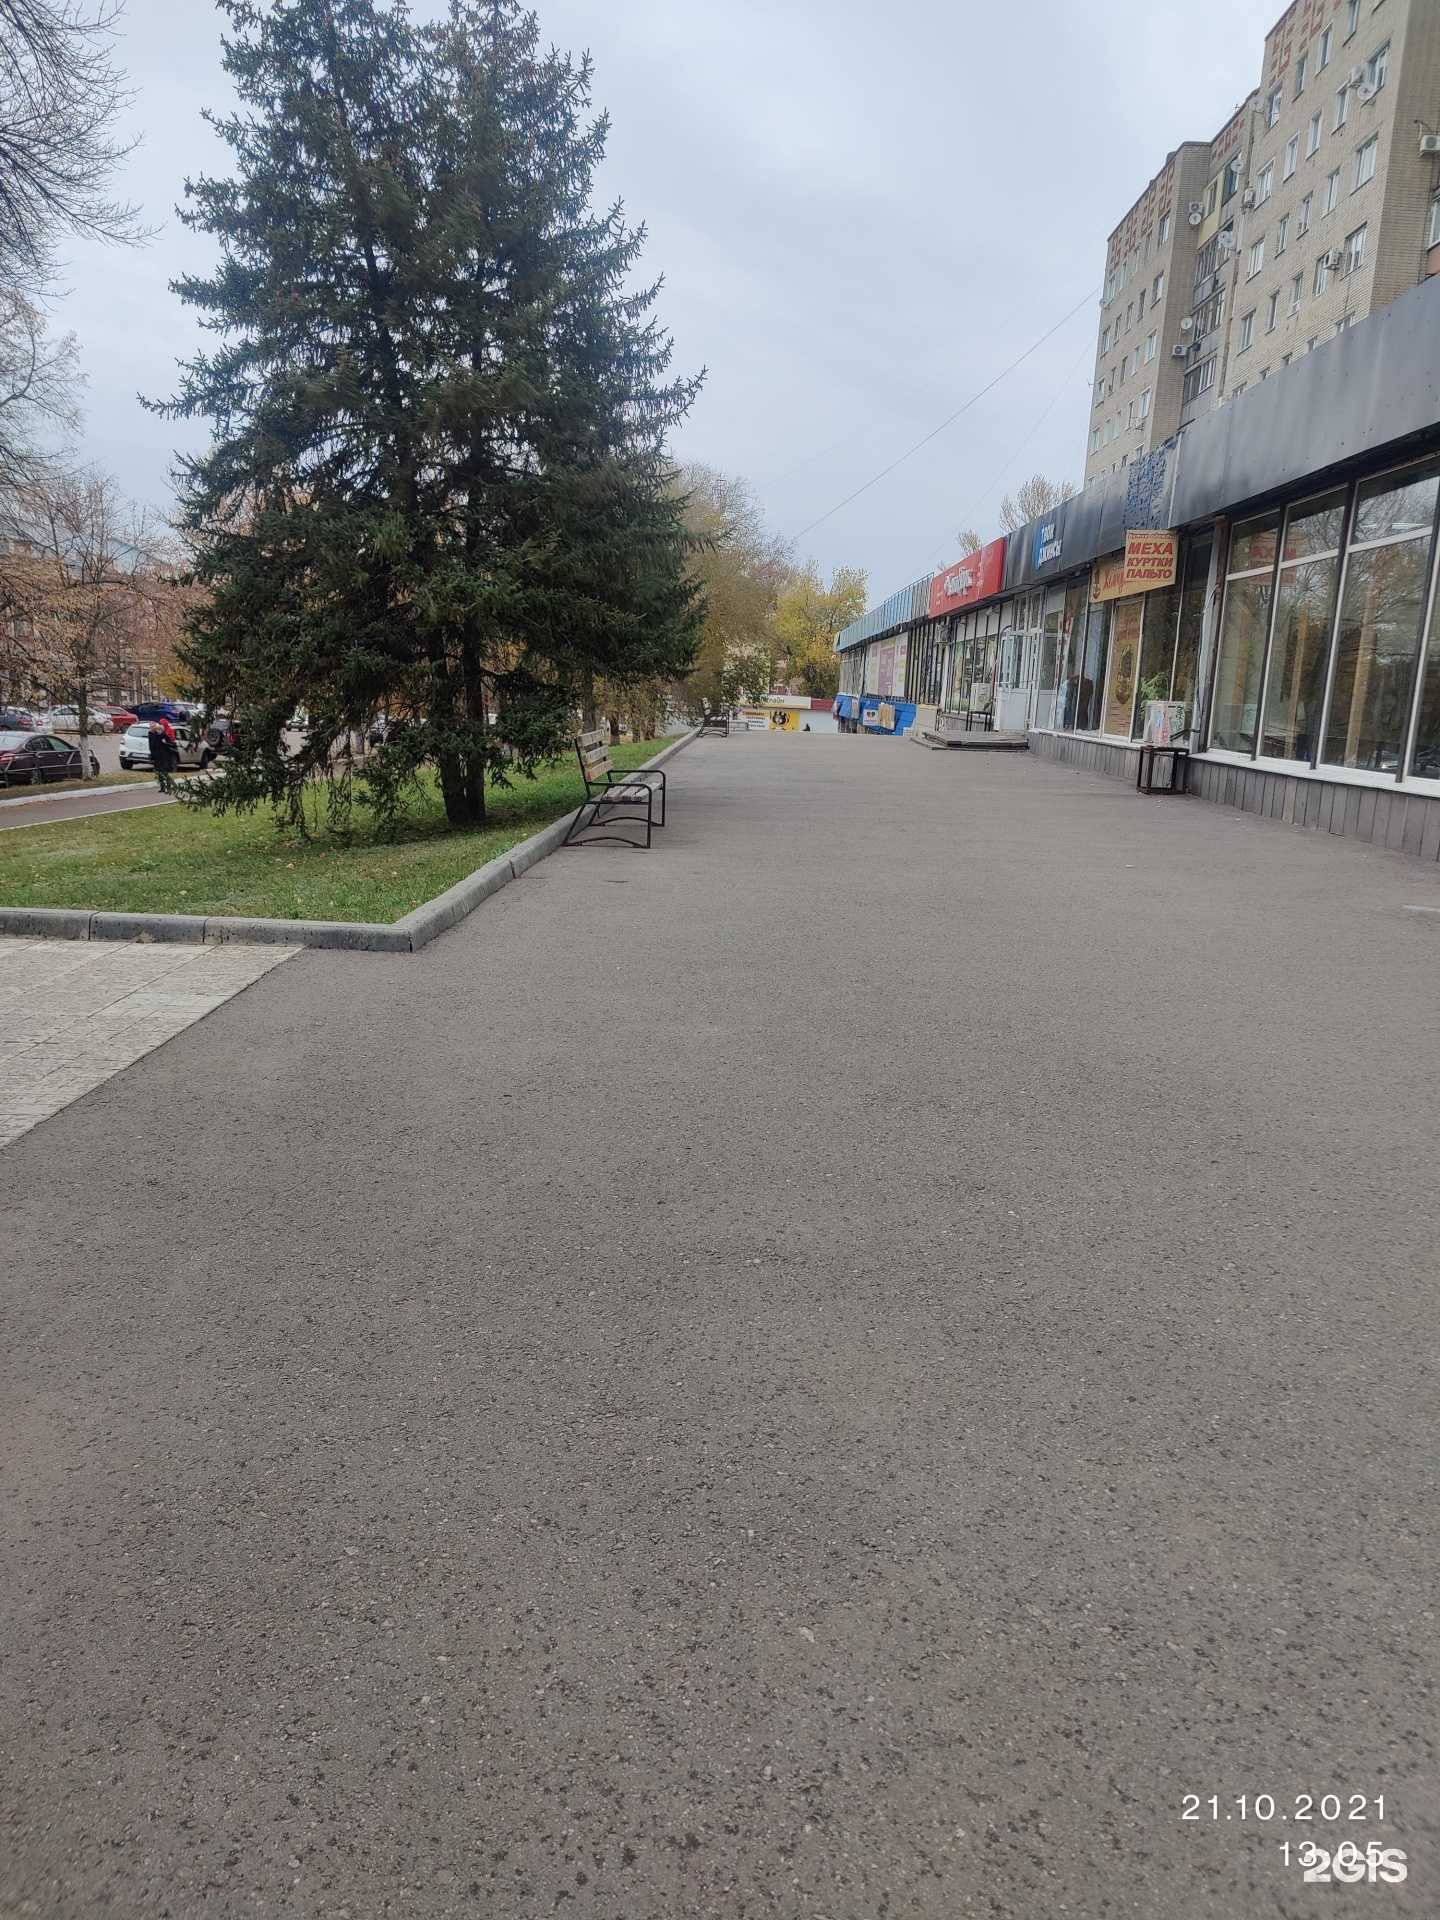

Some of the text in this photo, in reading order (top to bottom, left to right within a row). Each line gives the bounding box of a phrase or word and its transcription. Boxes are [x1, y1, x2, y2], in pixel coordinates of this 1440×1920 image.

[1128, 542, 1173, 555] МЕХА
[1127, 557, 1174, 567] КУРТКИ
[1127, 569, 1173, 579] ПАЛЬТО
